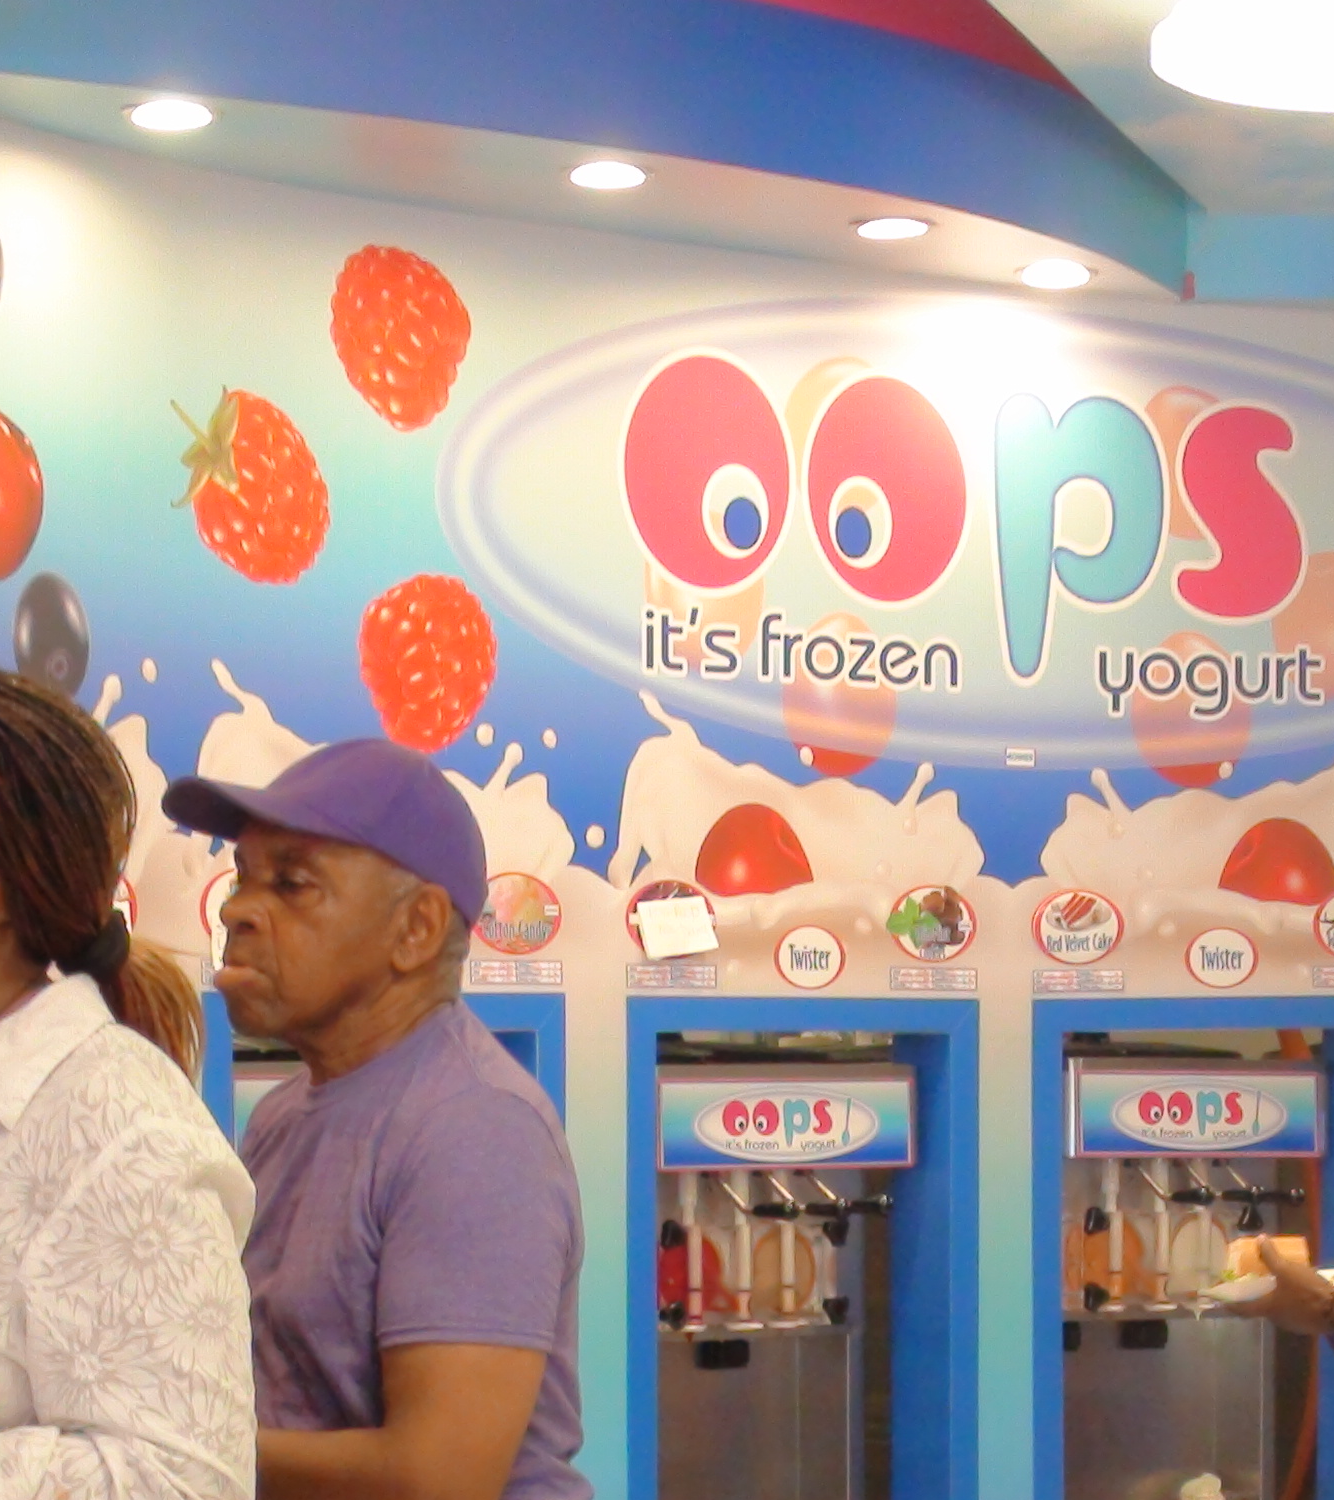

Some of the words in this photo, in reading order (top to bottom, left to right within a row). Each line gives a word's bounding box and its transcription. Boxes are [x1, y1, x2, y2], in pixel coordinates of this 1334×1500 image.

[643, 608, 738, 674] it's
[759, 613, 961, 690] frozen
[1097, 647, 1324, 717] yogurt
[788, 943, 831, 971] Twister
[1199, 945, 1245, 971] Twister
